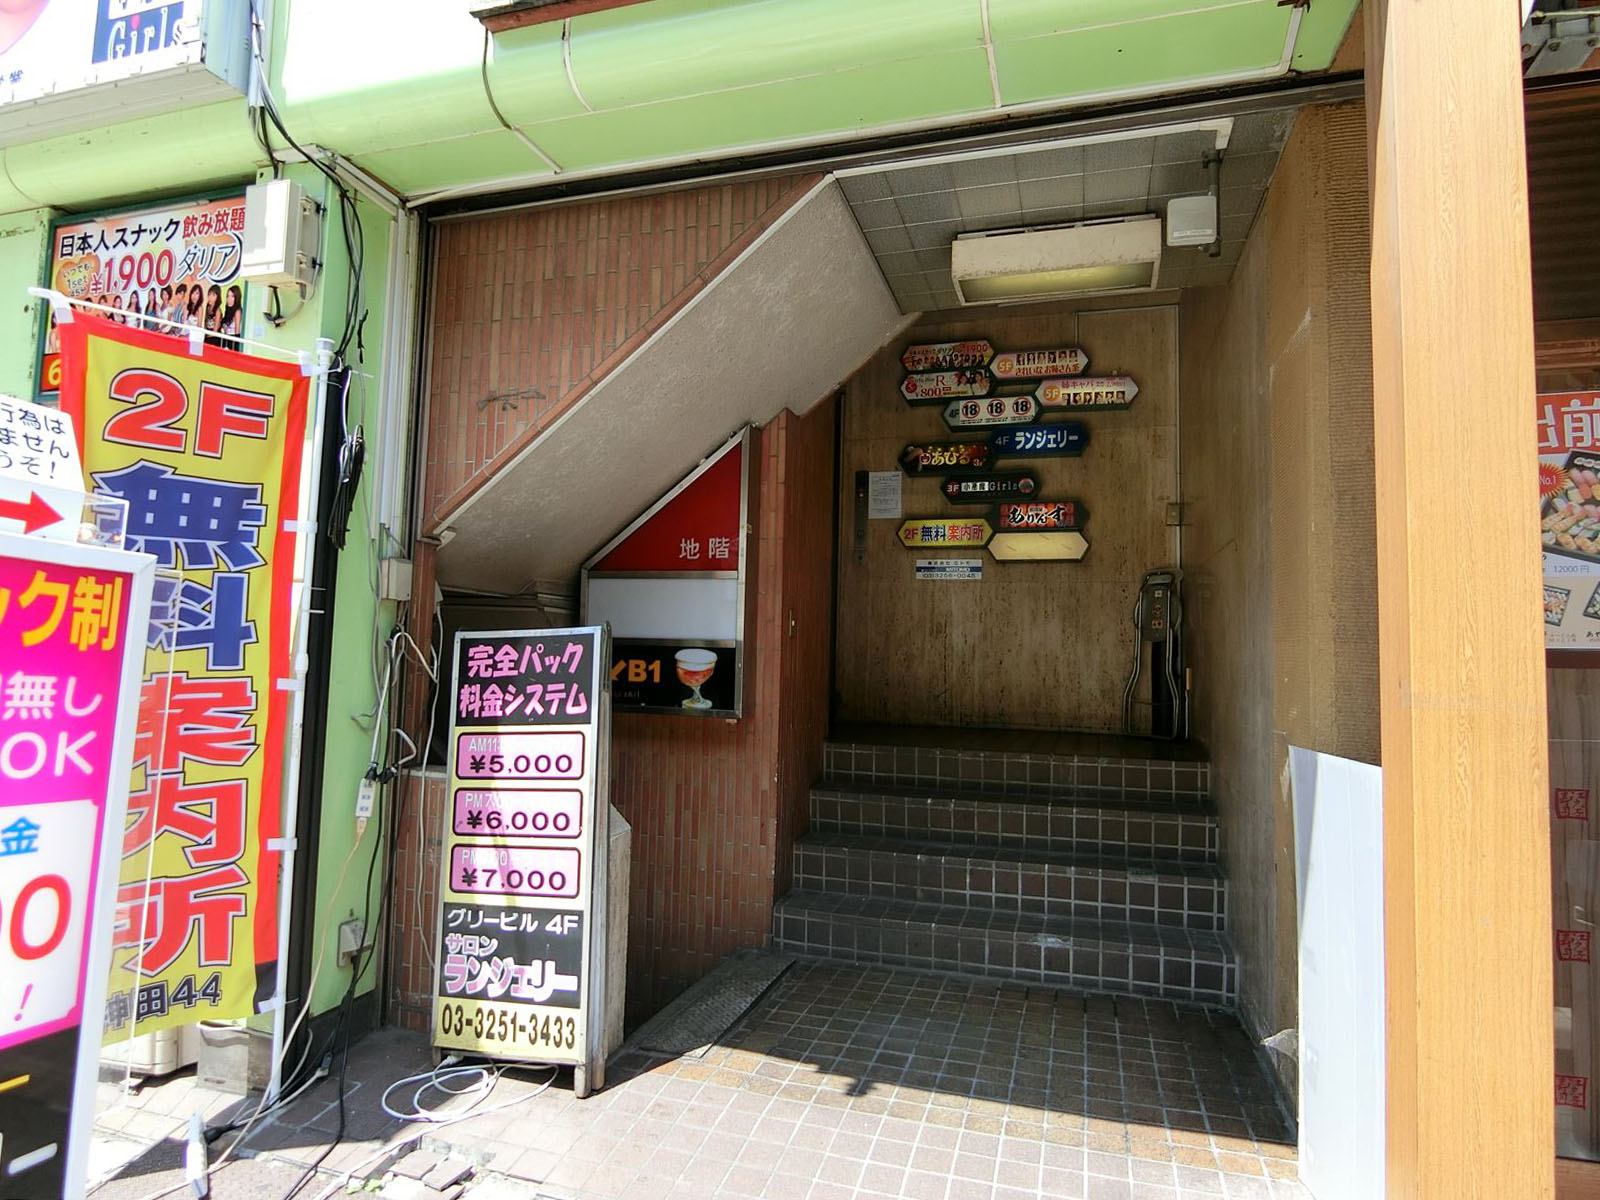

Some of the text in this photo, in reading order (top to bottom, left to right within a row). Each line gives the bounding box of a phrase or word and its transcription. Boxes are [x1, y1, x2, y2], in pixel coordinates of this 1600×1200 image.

[107, 7, 184, 61] Girls
[60, 207, 245, 258] 日本人スナック 飲み放題
[175, 244, 238, 282] ダリア
[999, 362, 1012, 371] 5F
[1045, 389, 1060, 398] 5F
[103, 367, 275, 459] 2F
[963, 404, 978, 416] 18
[988, 403, 1003, 415] 18
[1013, 401, 1029, 413] 18
[995, 430, 1079, 450] 4F ランジェリー
[946, 483, 960, 492] 3F
[904, 525, 984, 541] 2F 無料案内所
[679, 537, 730, 560] 地階
[468, 642, 583, 677] 完全パック
[627, 658, 662, 684] B1
[0, 670, 103, 720] 無し
[460, 683, 587, 717] 料金システム
[90, 459, 268, 978] 無料案内所
[0, 730, 96, 779] OK
[469, 754, 573, 774] ¥5,000
[466, 809, 570, 831] ¥6,000
[461, 868, 566, 890] ¥7,000
[0, 873, 72, 961] 0
[447, 909, 579, 934] グリービル 4F
[445, 933, 498, 956] サロン
[444, 954, 578, 1002] ランジェリー
[442, 1004, 575, 1049] 03-3251-3433
